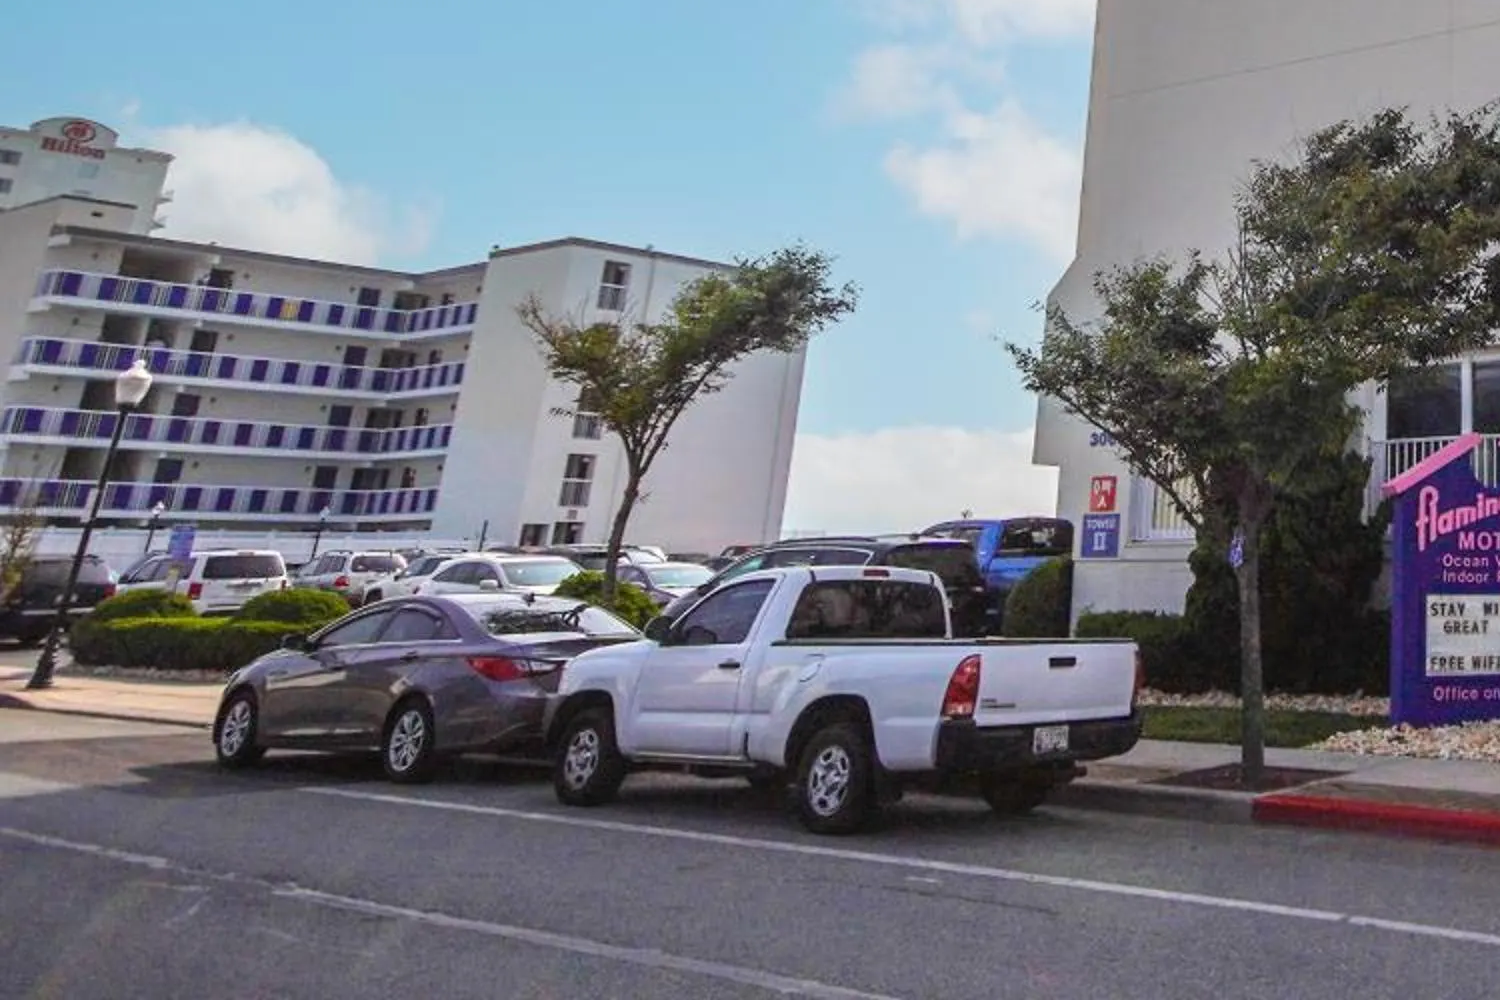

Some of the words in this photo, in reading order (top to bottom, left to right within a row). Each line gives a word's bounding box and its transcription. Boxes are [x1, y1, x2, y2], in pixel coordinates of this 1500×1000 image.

[1442, 552, 1490, 568] Ocean
[1442, 568, 1490, 584] Indoor
[1430, 602, 1465, 616] STAY
[1443, 620, 1489, 634] GREAT
[1430, 655, 1465, 670] FREE
[1471, 655, 1500, 669] WIFI
[1433, 685, 1479, 701] Office
[1483, 687, 1500, 699] on
